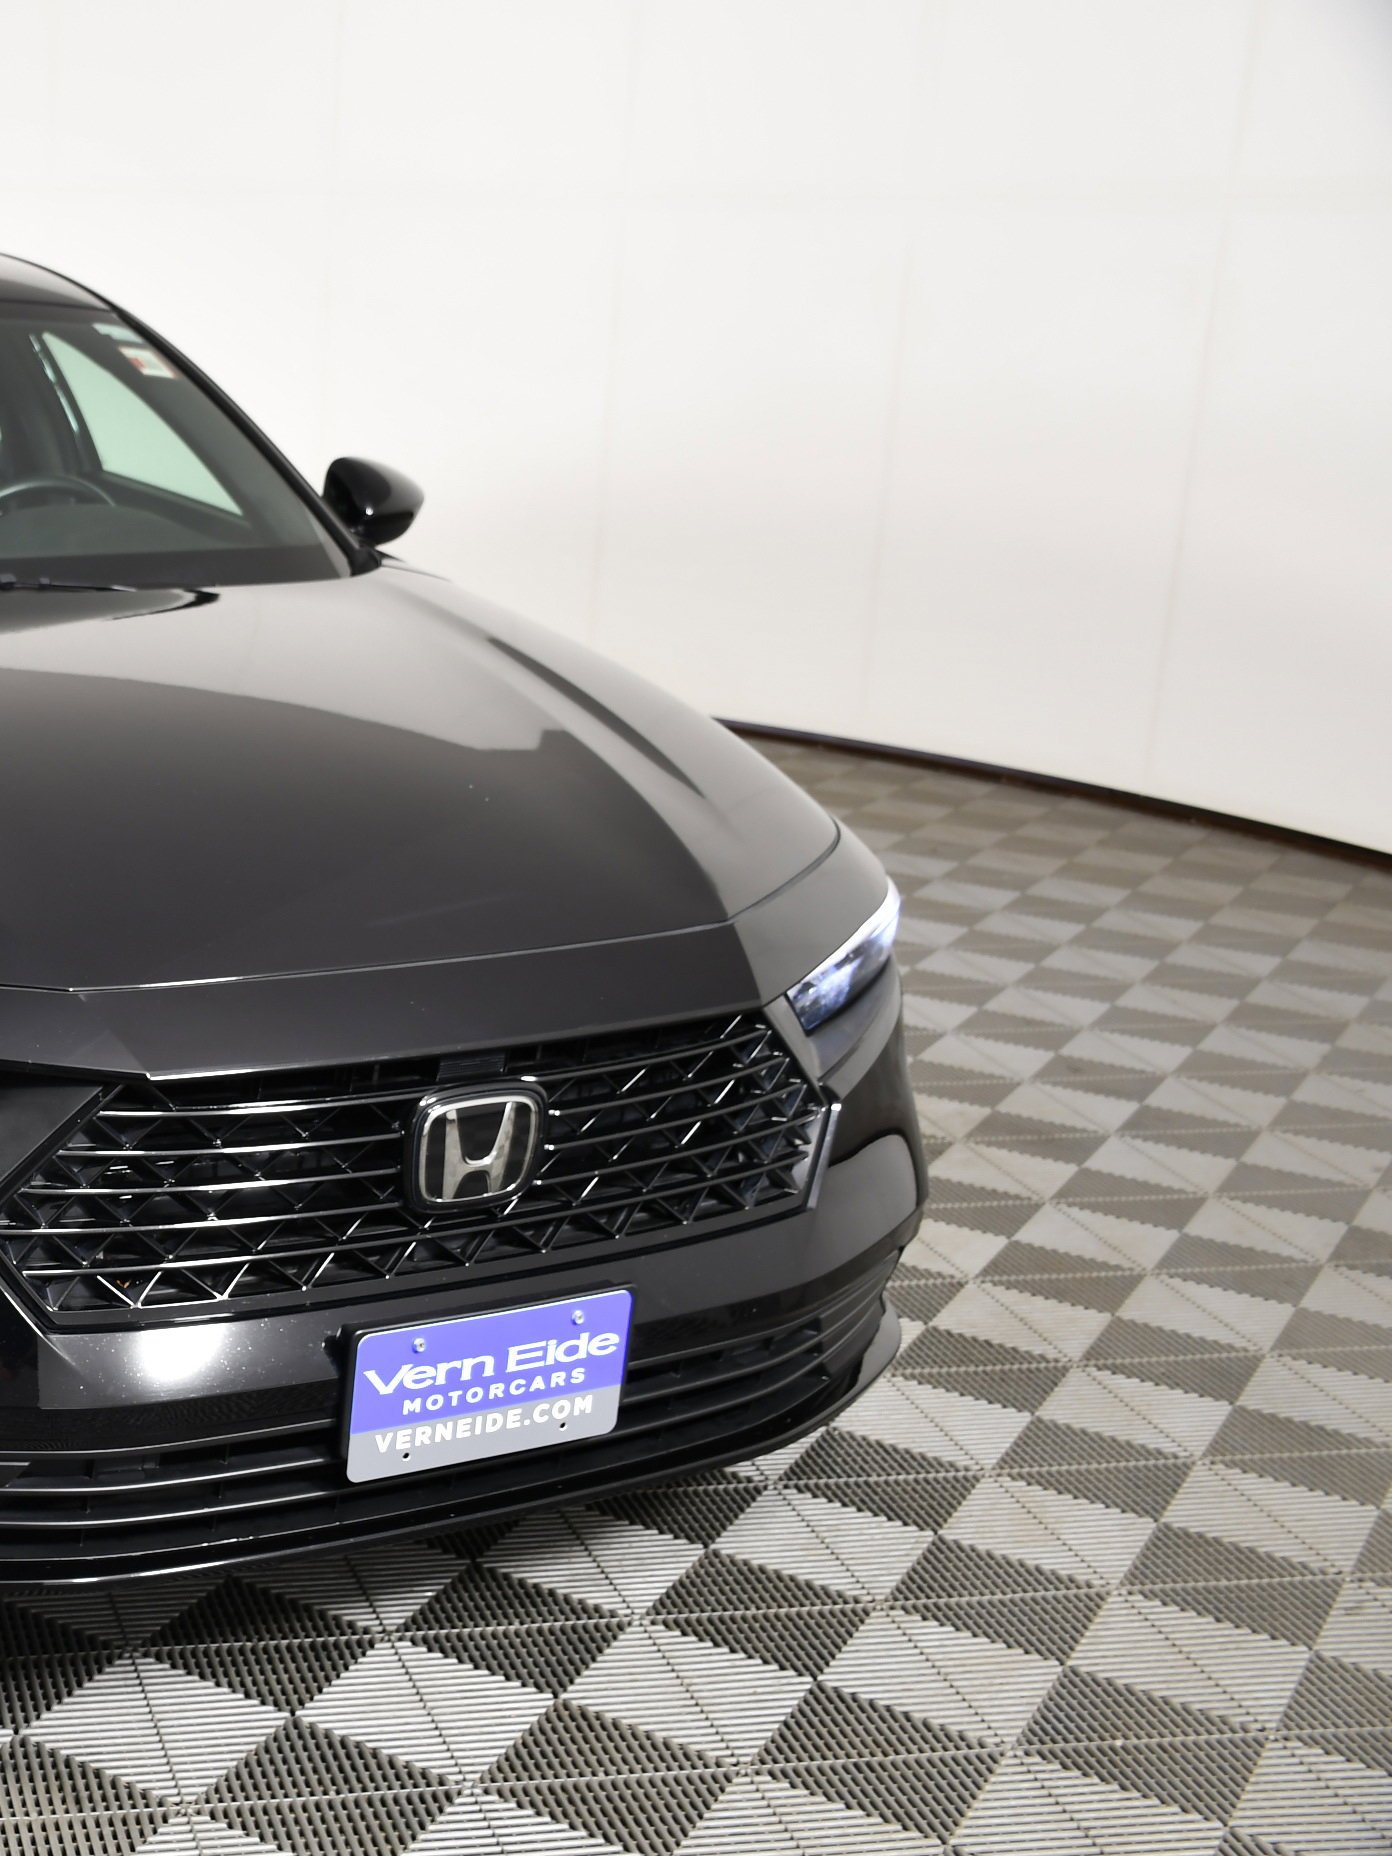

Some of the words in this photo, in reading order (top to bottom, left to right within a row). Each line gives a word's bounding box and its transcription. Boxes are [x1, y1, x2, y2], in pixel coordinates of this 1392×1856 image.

[363, 1354, 494, 1395] Vern
[505, 1331, 620, 1373] Eide
[402, 1367, 586, 1415] MOTORCARS
[375, 1394, 593, 1453] VERNEIDE.COM
